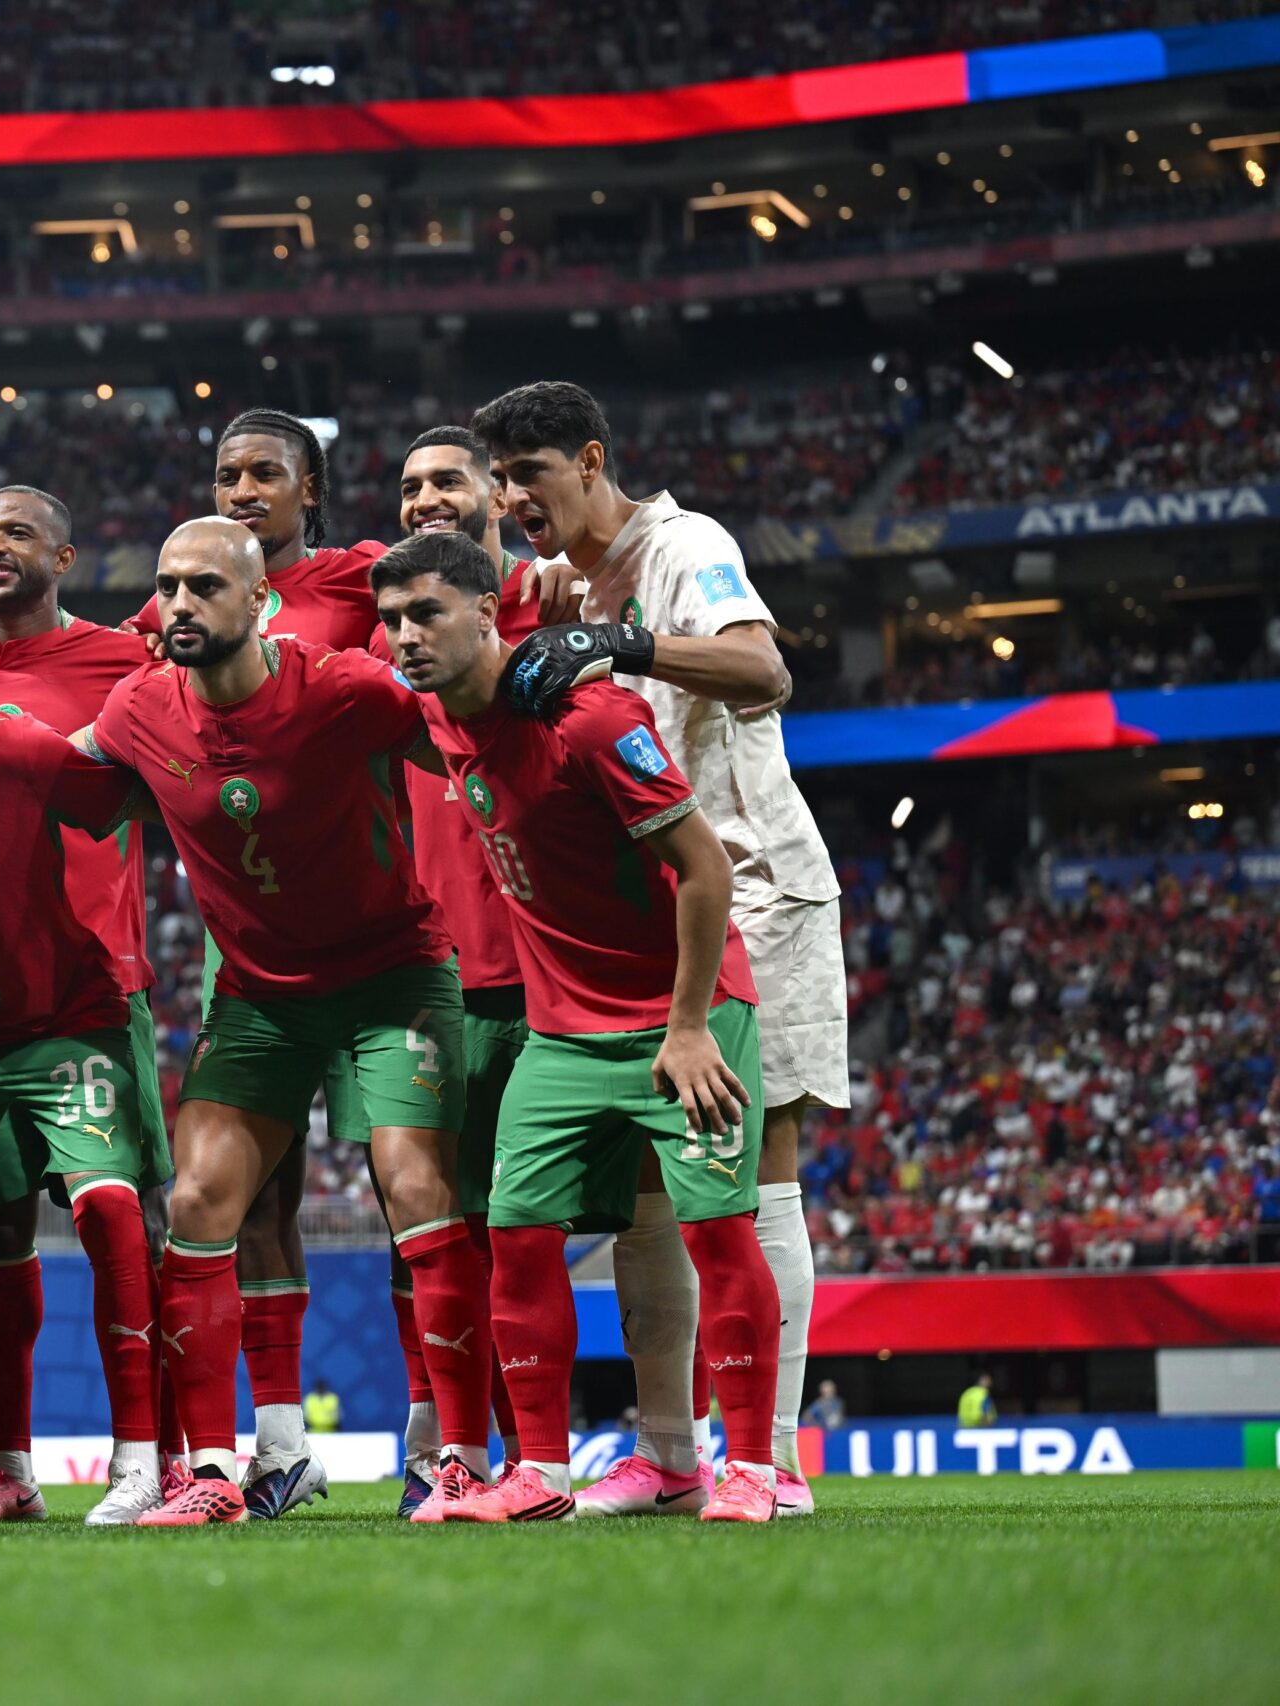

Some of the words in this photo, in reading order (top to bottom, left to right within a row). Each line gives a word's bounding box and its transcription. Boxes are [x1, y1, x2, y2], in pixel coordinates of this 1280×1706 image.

[1016, 486, 1268, 538] ATLANTA
[241, 834, 280, 894] 4
[478, 830, 534, 901] 10
[406, 1008, 440, 1073] 4
[50, 1054, 116, 1126] 26
